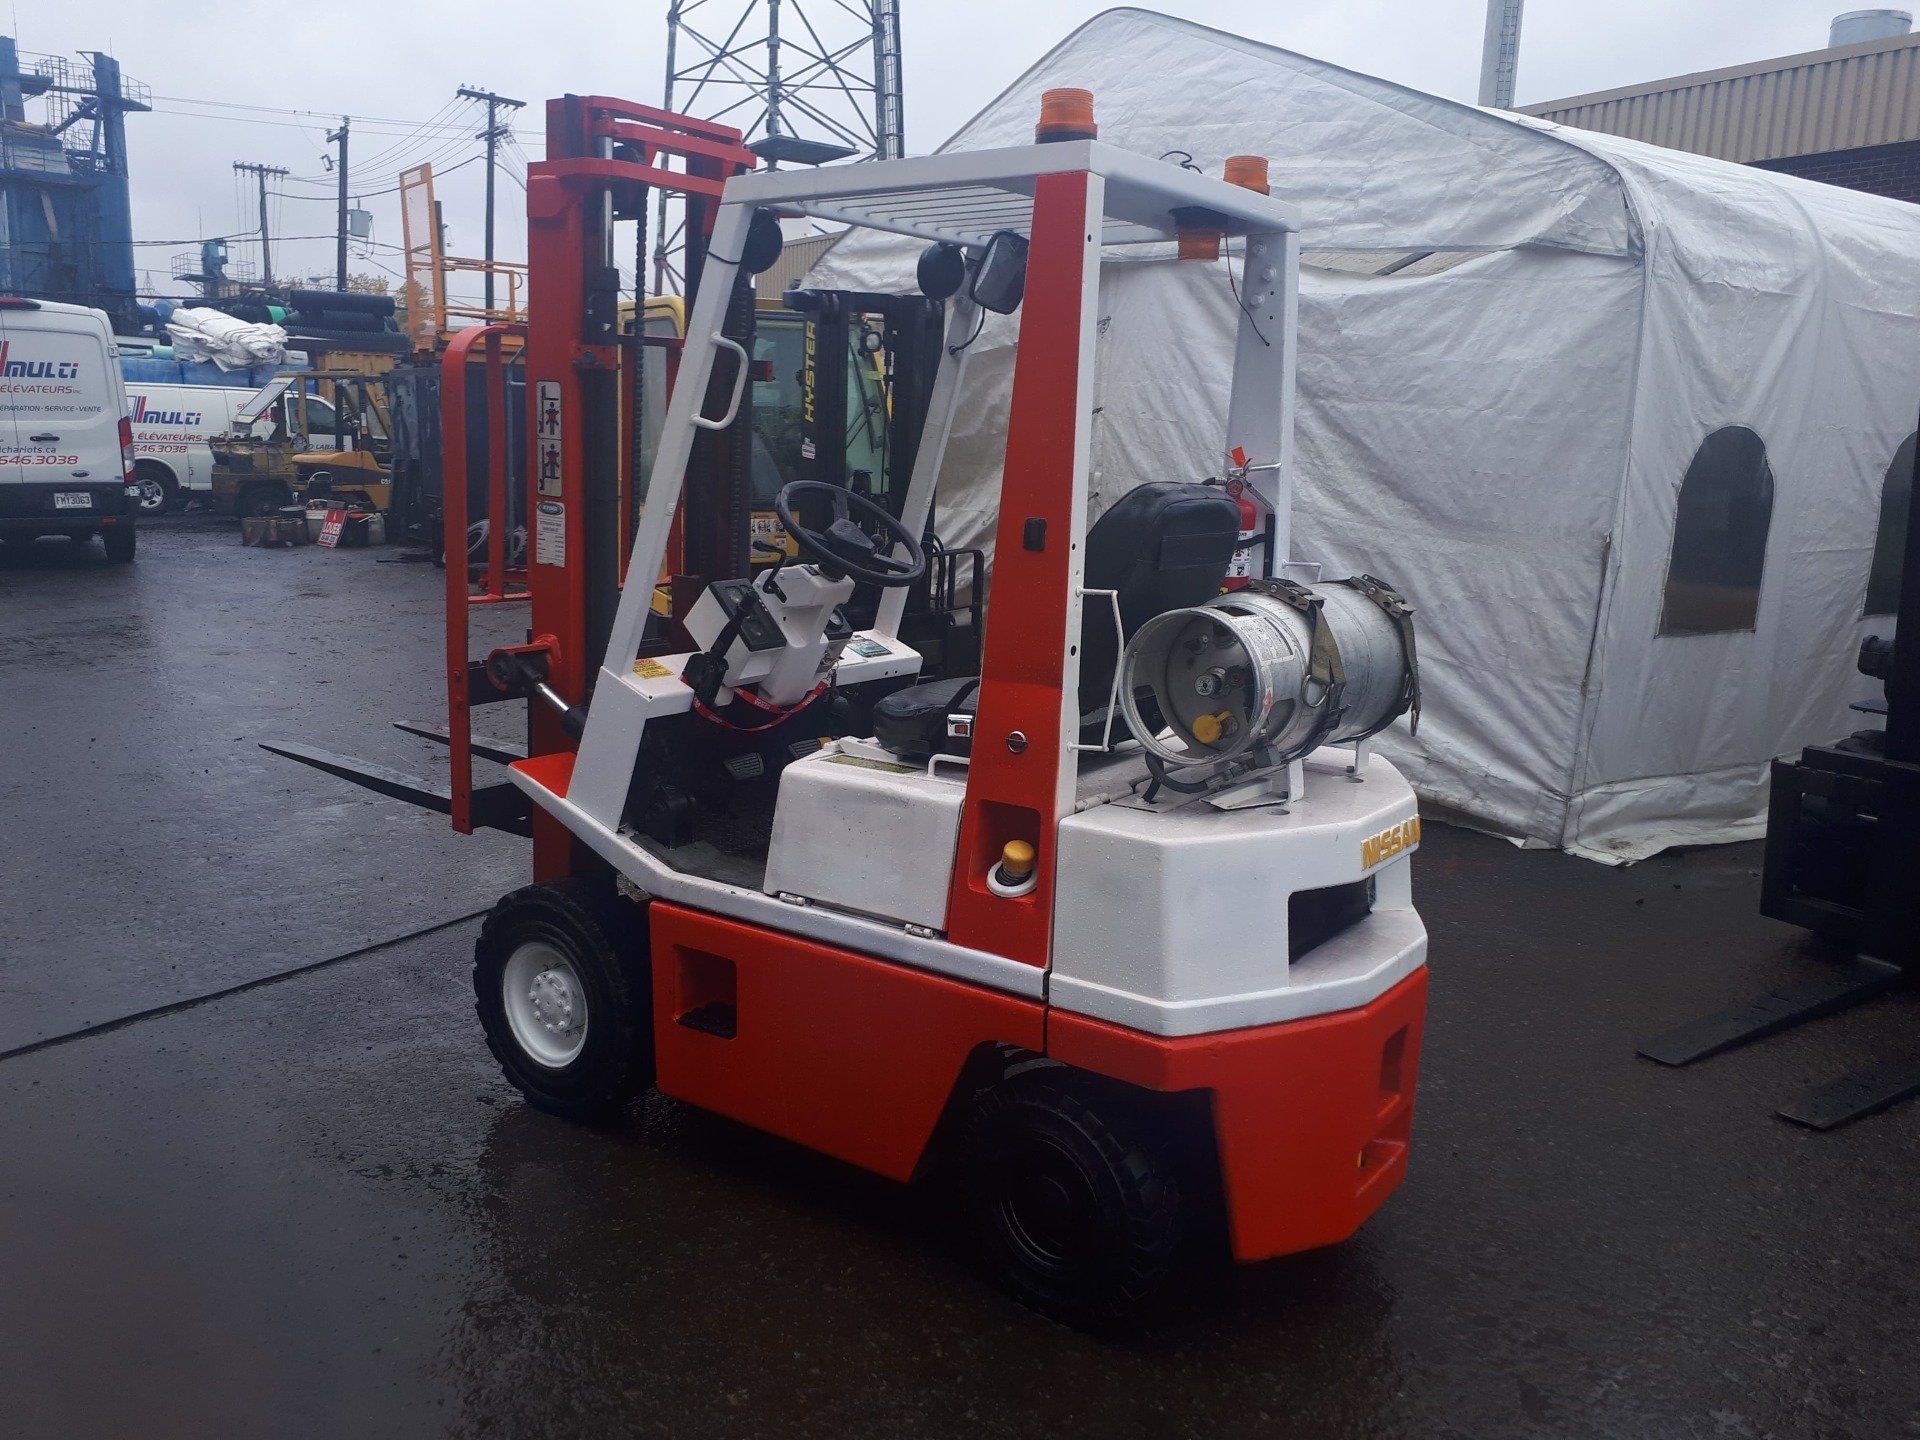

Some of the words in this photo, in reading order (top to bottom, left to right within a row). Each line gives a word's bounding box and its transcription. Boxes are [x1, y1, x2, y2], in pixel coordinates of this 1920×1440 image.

[803, 320, 816, 423] HYSTER
[79, 405, 102, 413] VENTE
[1361, 813, 1421, 872] NISSAN
